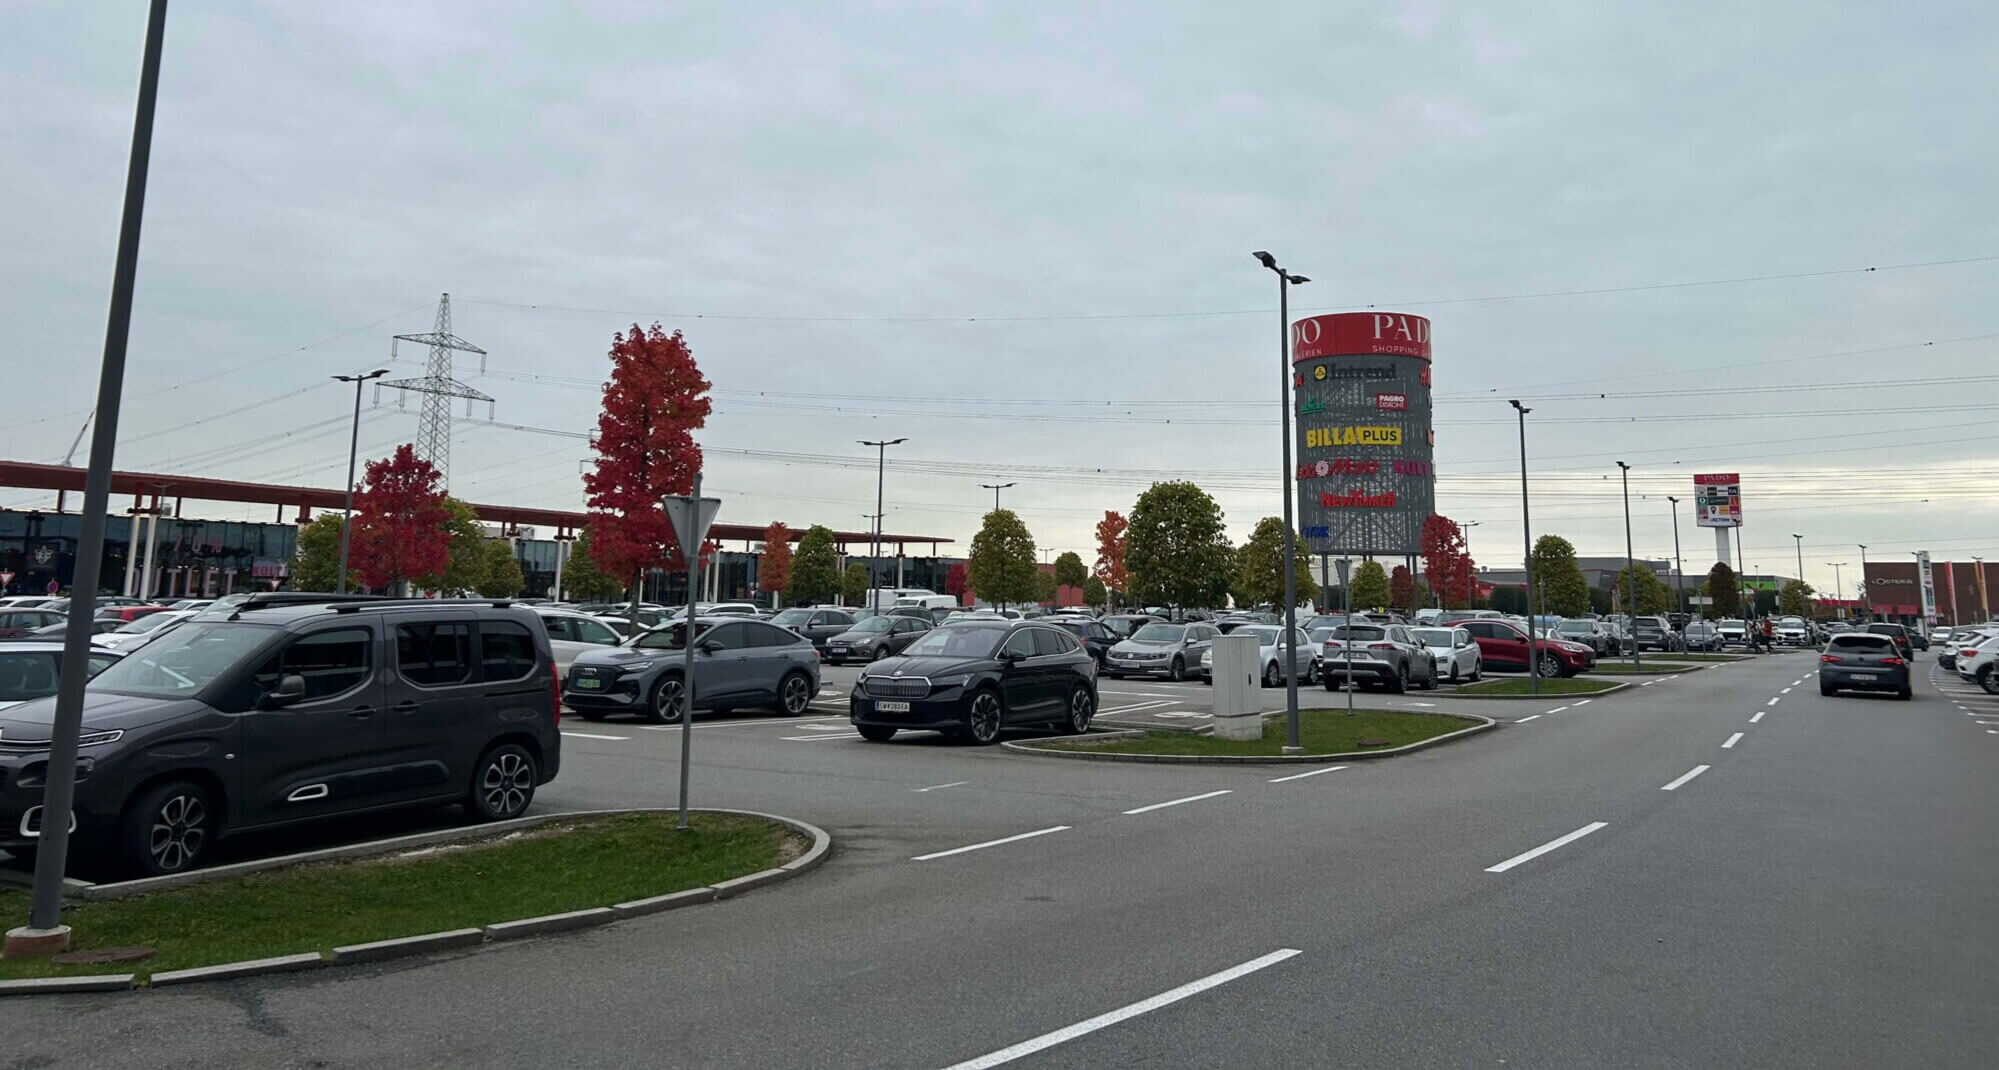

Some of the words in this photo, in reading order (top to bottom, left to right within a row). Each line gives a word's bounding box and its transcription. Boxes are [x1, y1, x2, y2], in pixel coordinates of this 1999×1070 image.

[1372, 344, 1418, 355] SHOPPING
[1306, 426, 1357, 448] BILLA
[1363, 430, 1397, 441] PLUS
